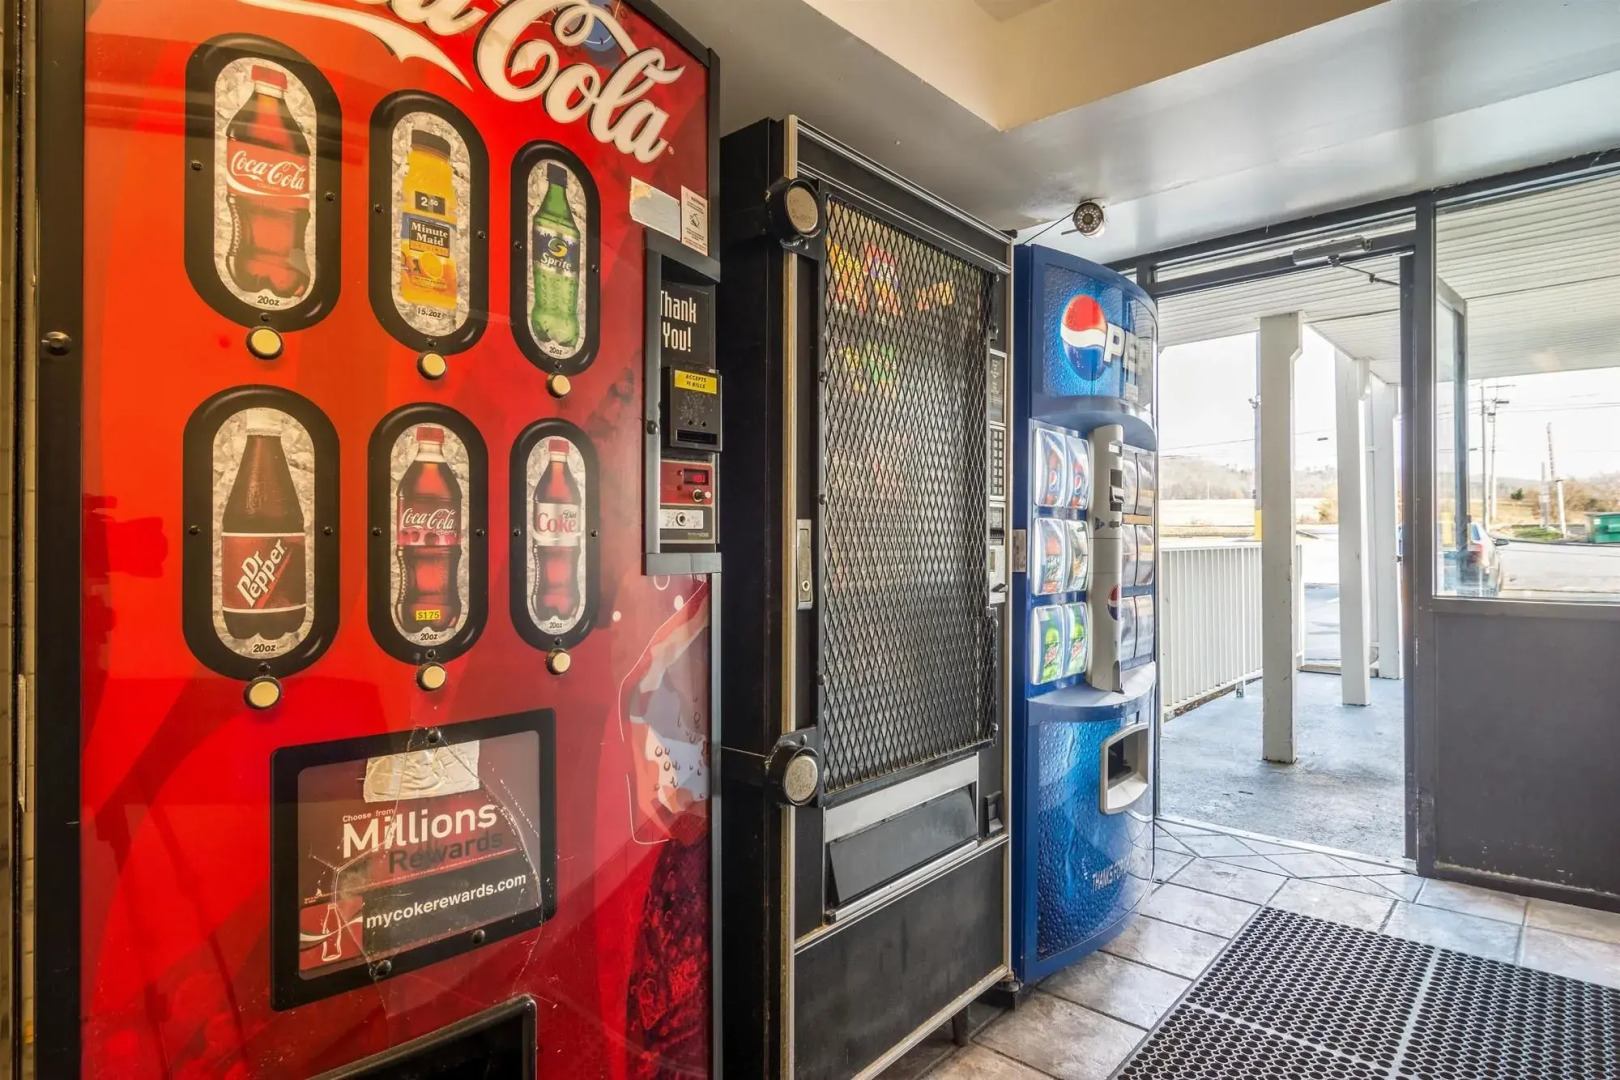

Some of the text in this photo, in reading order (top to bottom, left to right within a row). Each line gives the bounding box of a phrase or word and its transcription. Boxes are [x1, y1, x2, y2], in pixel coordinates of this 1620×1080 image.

[231, 150, 306, 190] Coca-Cola
[411, 221, 449, 239] Minute
[416, 232, 444, 247] Maid
[540, 252, 572, 271] Sprite
[257, 295, 280, 307] 20oz
[660, 290, 697, 324] Thank
[417, 307, 442, 319] 15.2oz
[662, 321, 692, 353] You!
[549, 346, 563, 356] 20oz
[685, 374, 707, 383] ACCEPTS
[401, 507, 456, 530] Coca-Cola
[536, 512, 576, 533] Coke
[562, 509, 577, 519] Diet
[236, 538, 285, 609] Pepper
[241, 550, 264, 580] Dr
[549, 621, 563, 629] 20oz
[420, 632, 439, 641] 20oz
[253, 643, 276, 653] 20oz
[342, 808, 395, 823] Choose from
[343, 804, 498, 859] Millions
[389, 830, 504, 875] Rewards
[366, 873, 527, 929] mycokerewards.com
